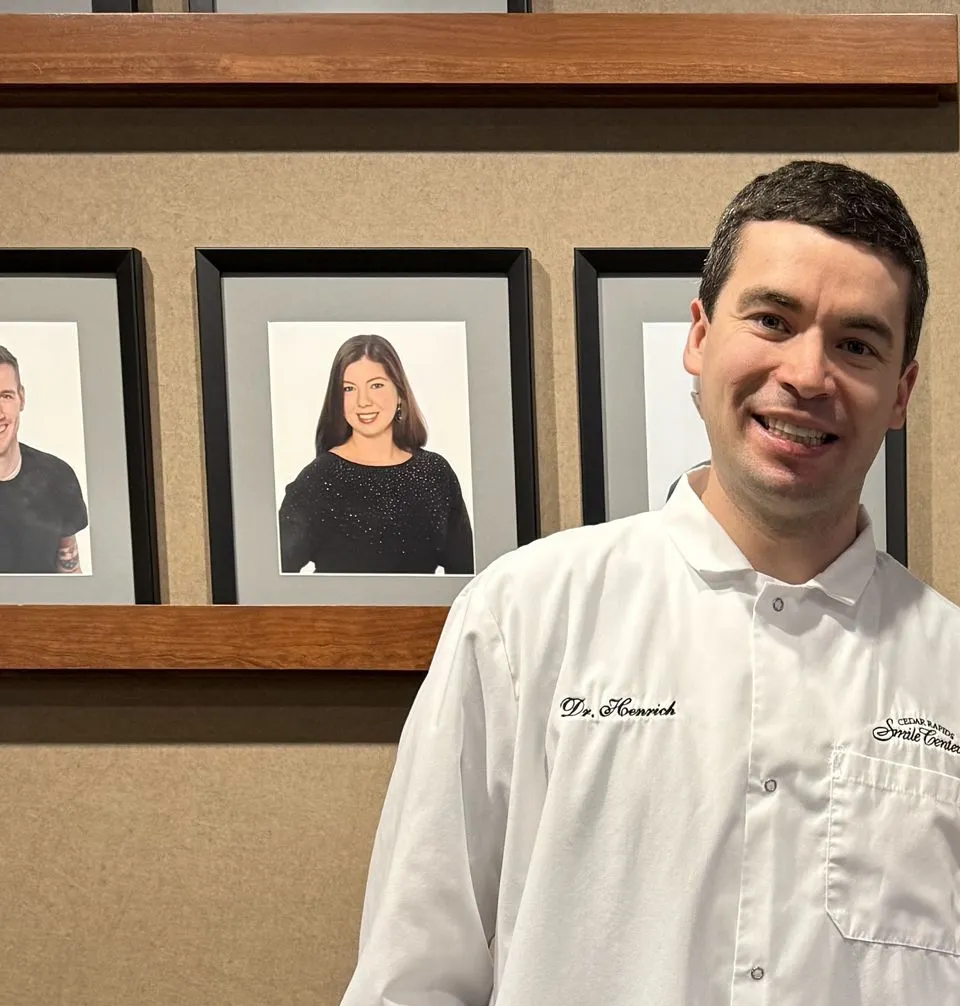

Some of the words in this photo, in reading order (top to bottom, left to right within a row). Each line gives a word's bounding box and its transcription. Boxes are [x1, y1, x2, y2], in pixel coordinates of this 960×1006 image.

[560, 697, 595, 718] Dr.
[599, 697, 677, 717] Henrich
[872, 718, 921, 742] Smile
[898, 718, 927, 726] CEDAR
[927, 720, 955, 740] RAPIDS
